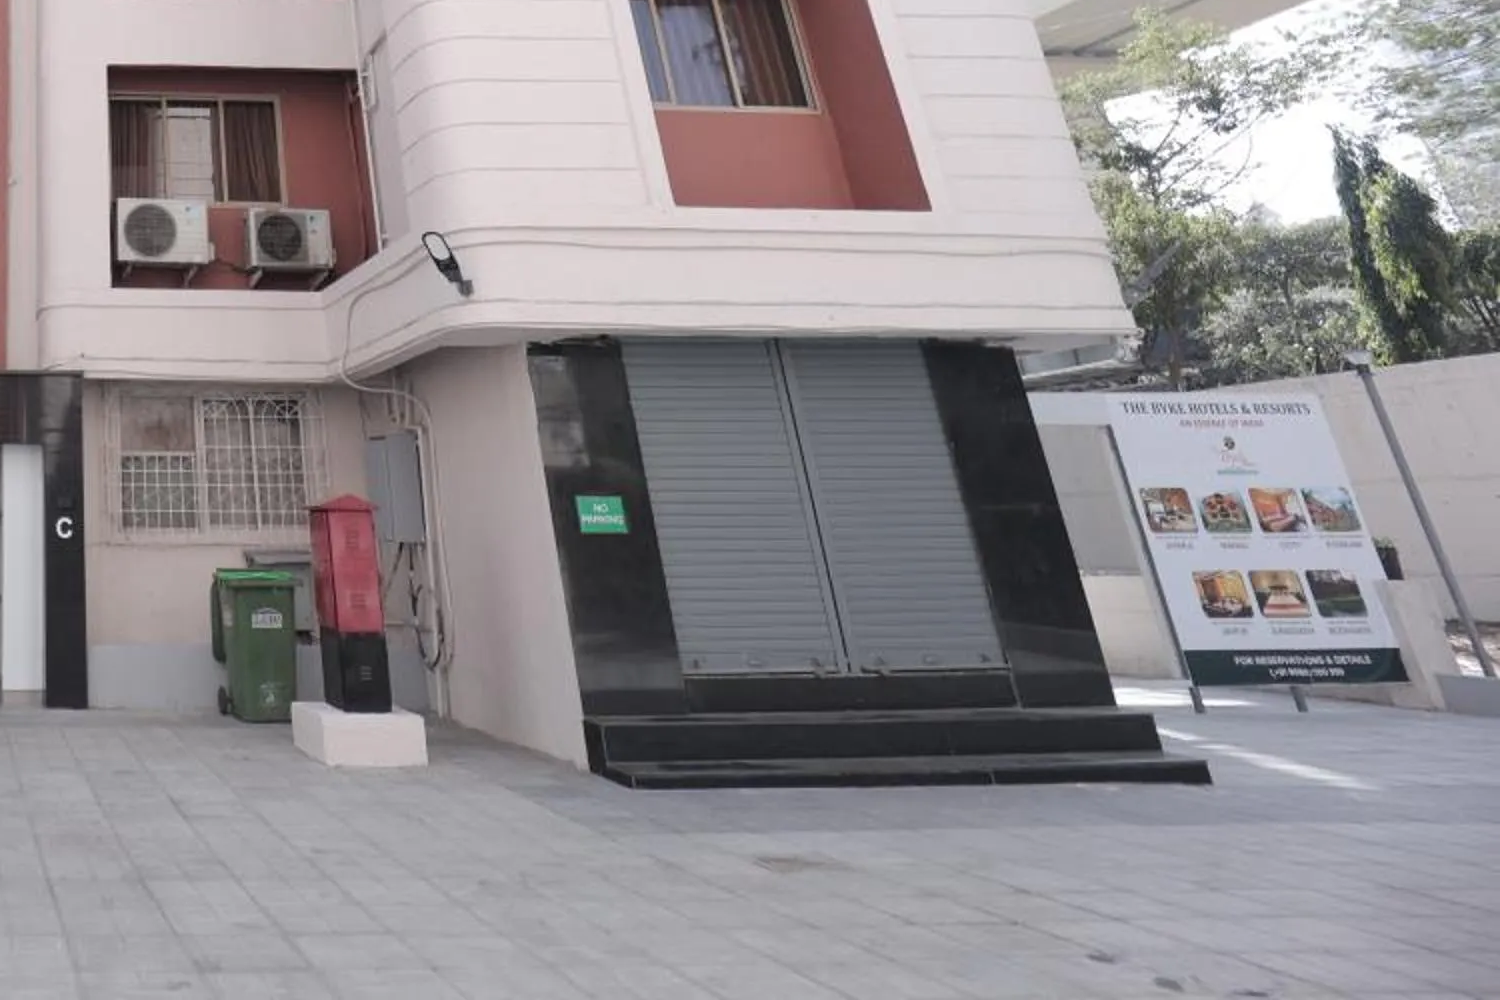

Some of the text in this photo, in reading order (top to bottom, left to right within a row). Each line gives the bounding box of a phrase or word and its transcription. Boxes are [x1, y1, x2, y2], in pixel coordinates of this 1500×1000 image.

[1121, 402, 1149, 415] THE
[1151, 402, 1186, 415] BYKE
[1188, 402, 1239, 415] HOTELS
[1253, 402, 1312, 415] RESORTS
[592, 503, 609, 513] NO
[580, 515, 625, 525] PARKING
[55, 516, 73, 539] C
